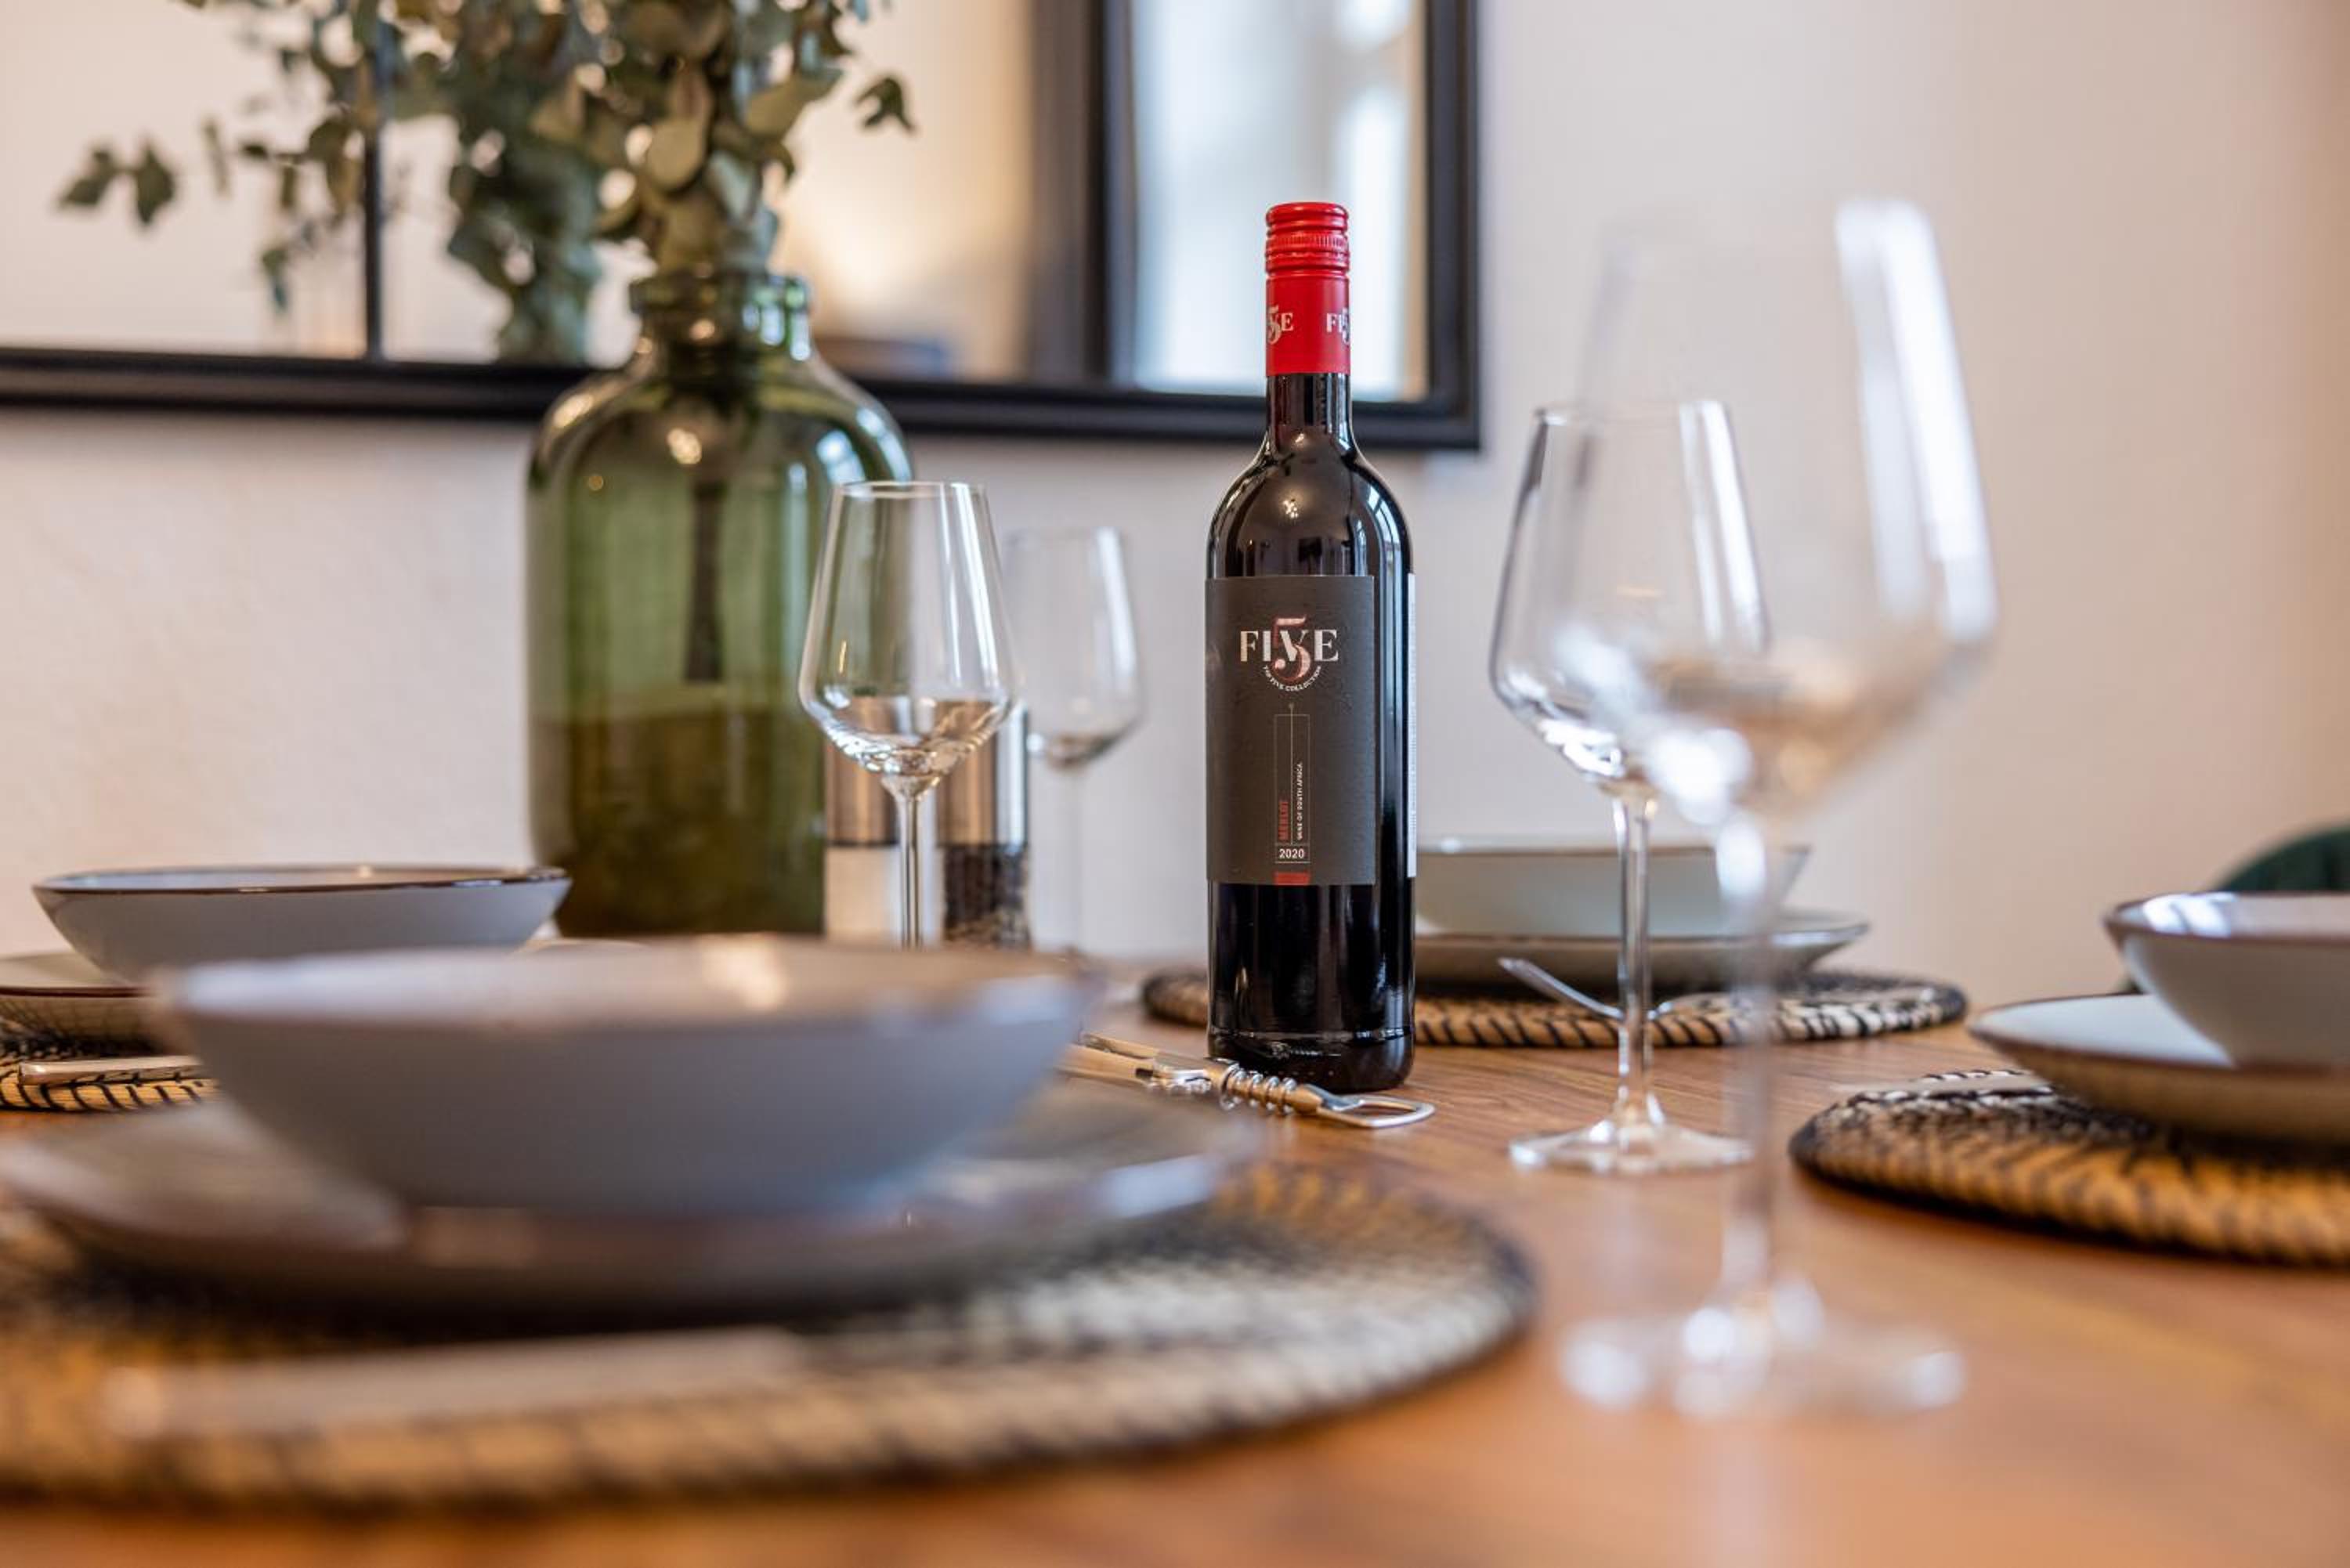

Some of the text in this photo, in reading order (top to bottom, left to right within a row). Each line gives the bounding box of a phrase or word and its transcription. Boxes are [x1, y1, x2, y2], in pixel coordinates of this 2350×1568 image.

[1240, 629, 1340, 663] FIVE
[1296, 812, 1303, 822] OF
[1278, 848, 1305, 859] 2020
